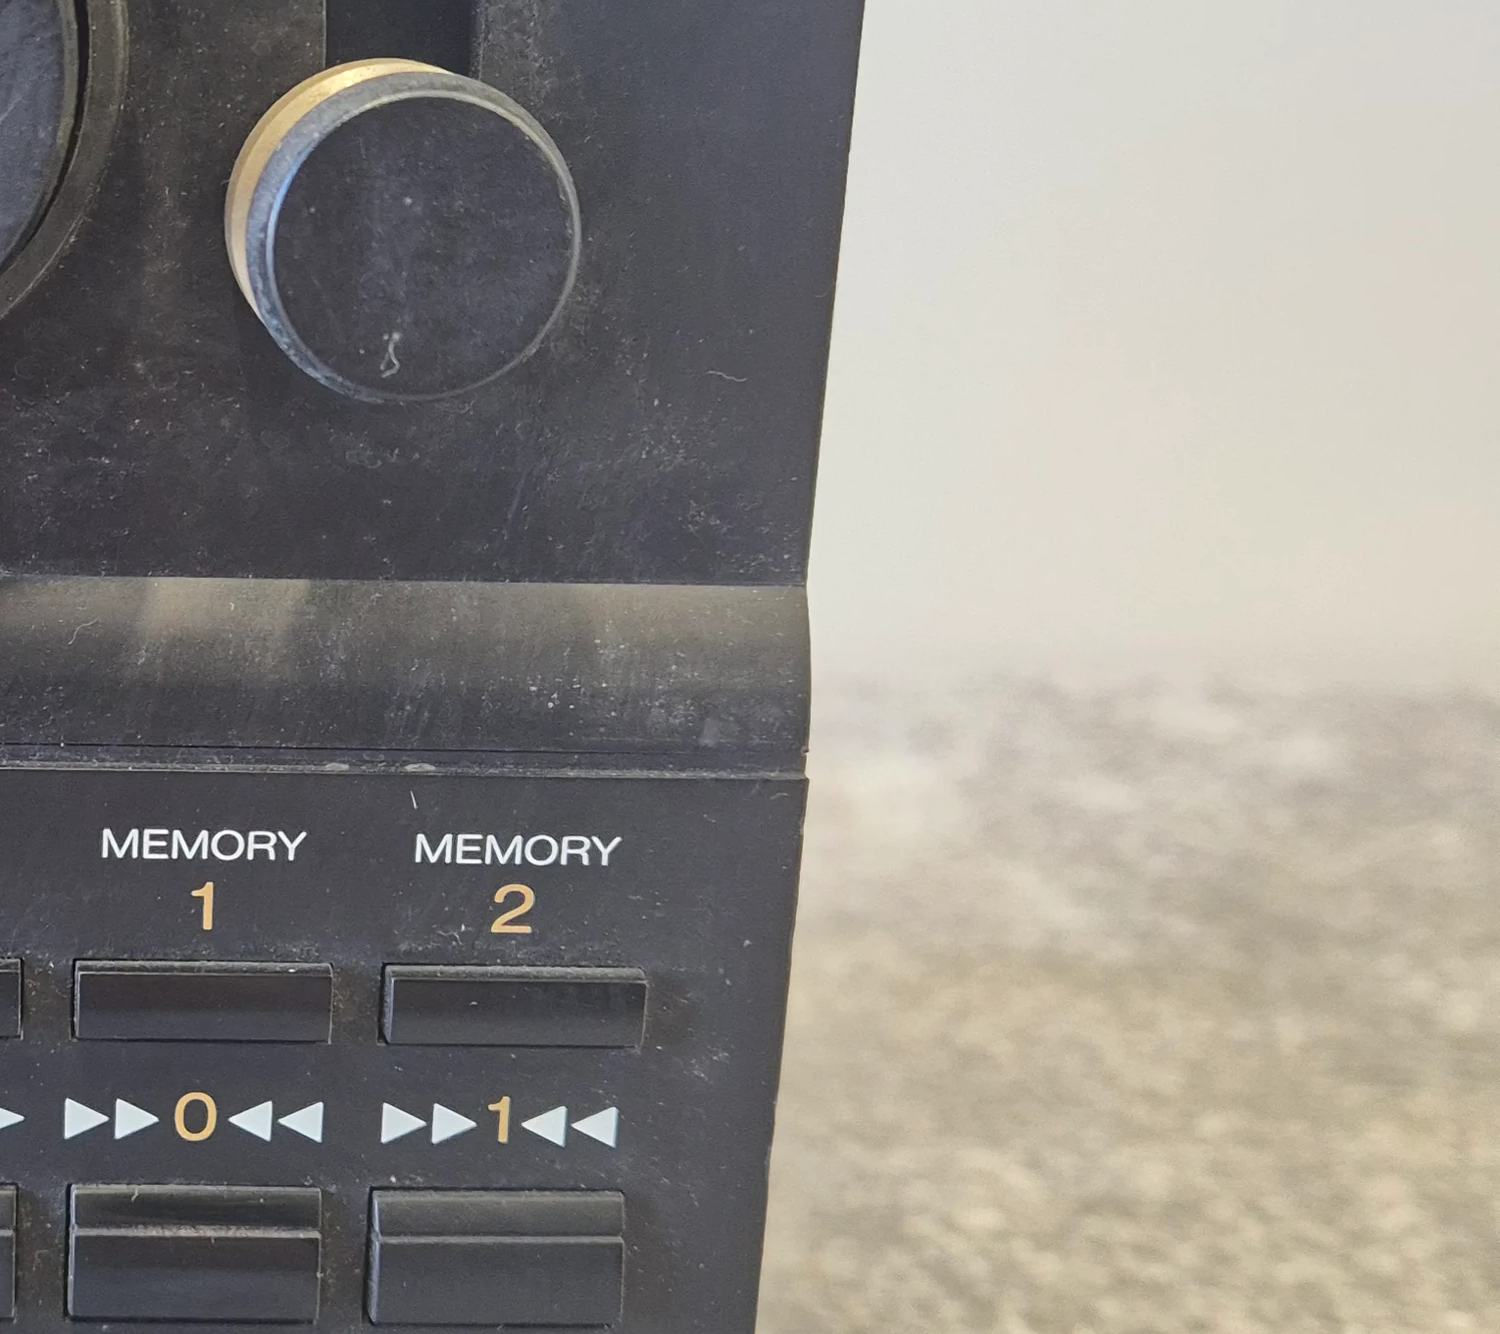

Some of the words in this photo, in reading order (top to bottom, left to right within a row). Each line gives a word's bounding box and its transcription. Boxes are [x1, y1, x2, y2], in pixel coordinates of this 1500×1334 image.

[100, 827, 308, 863] MEMORY
[413, 832, 623, 868] MEMORY
[189, 880, 216, 932] 1
[491, 883, 536, 935] 2
[486, 1095, 512, 1146] 1
